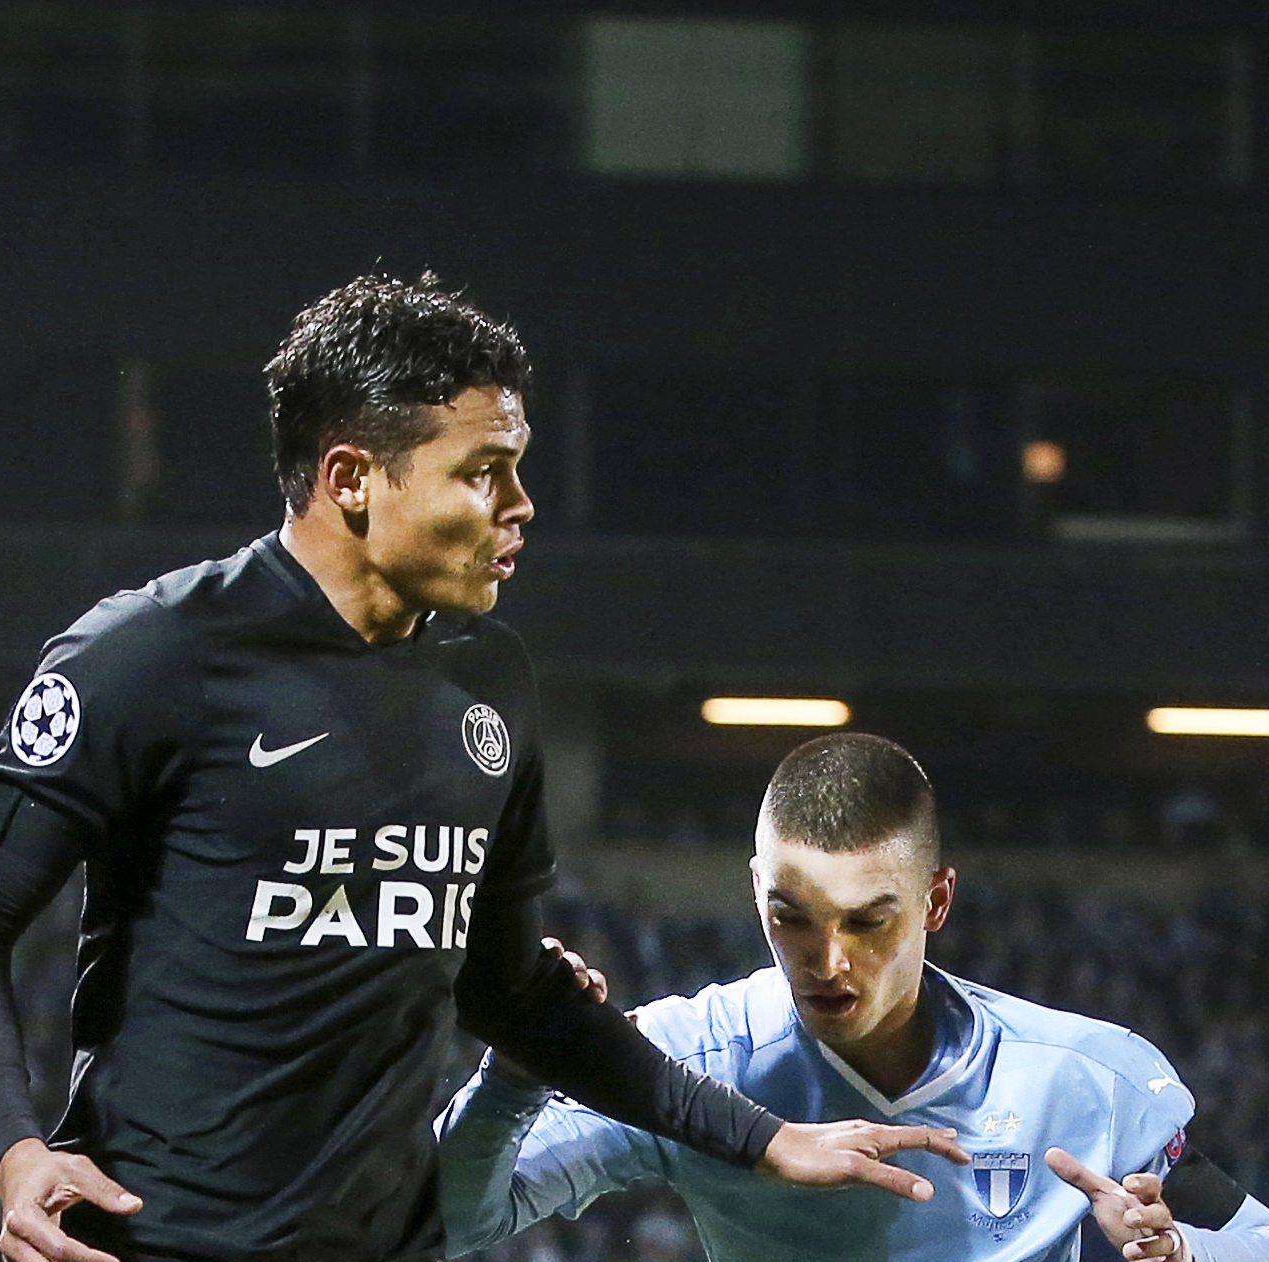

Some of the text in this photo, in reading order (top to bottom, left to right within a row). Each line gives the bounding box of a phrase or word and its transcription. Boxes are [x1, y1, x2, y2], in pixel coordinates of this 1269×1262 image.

[283, 824, 489, 875] JE SUIS
[245, 879, 477, 950] PARIS
